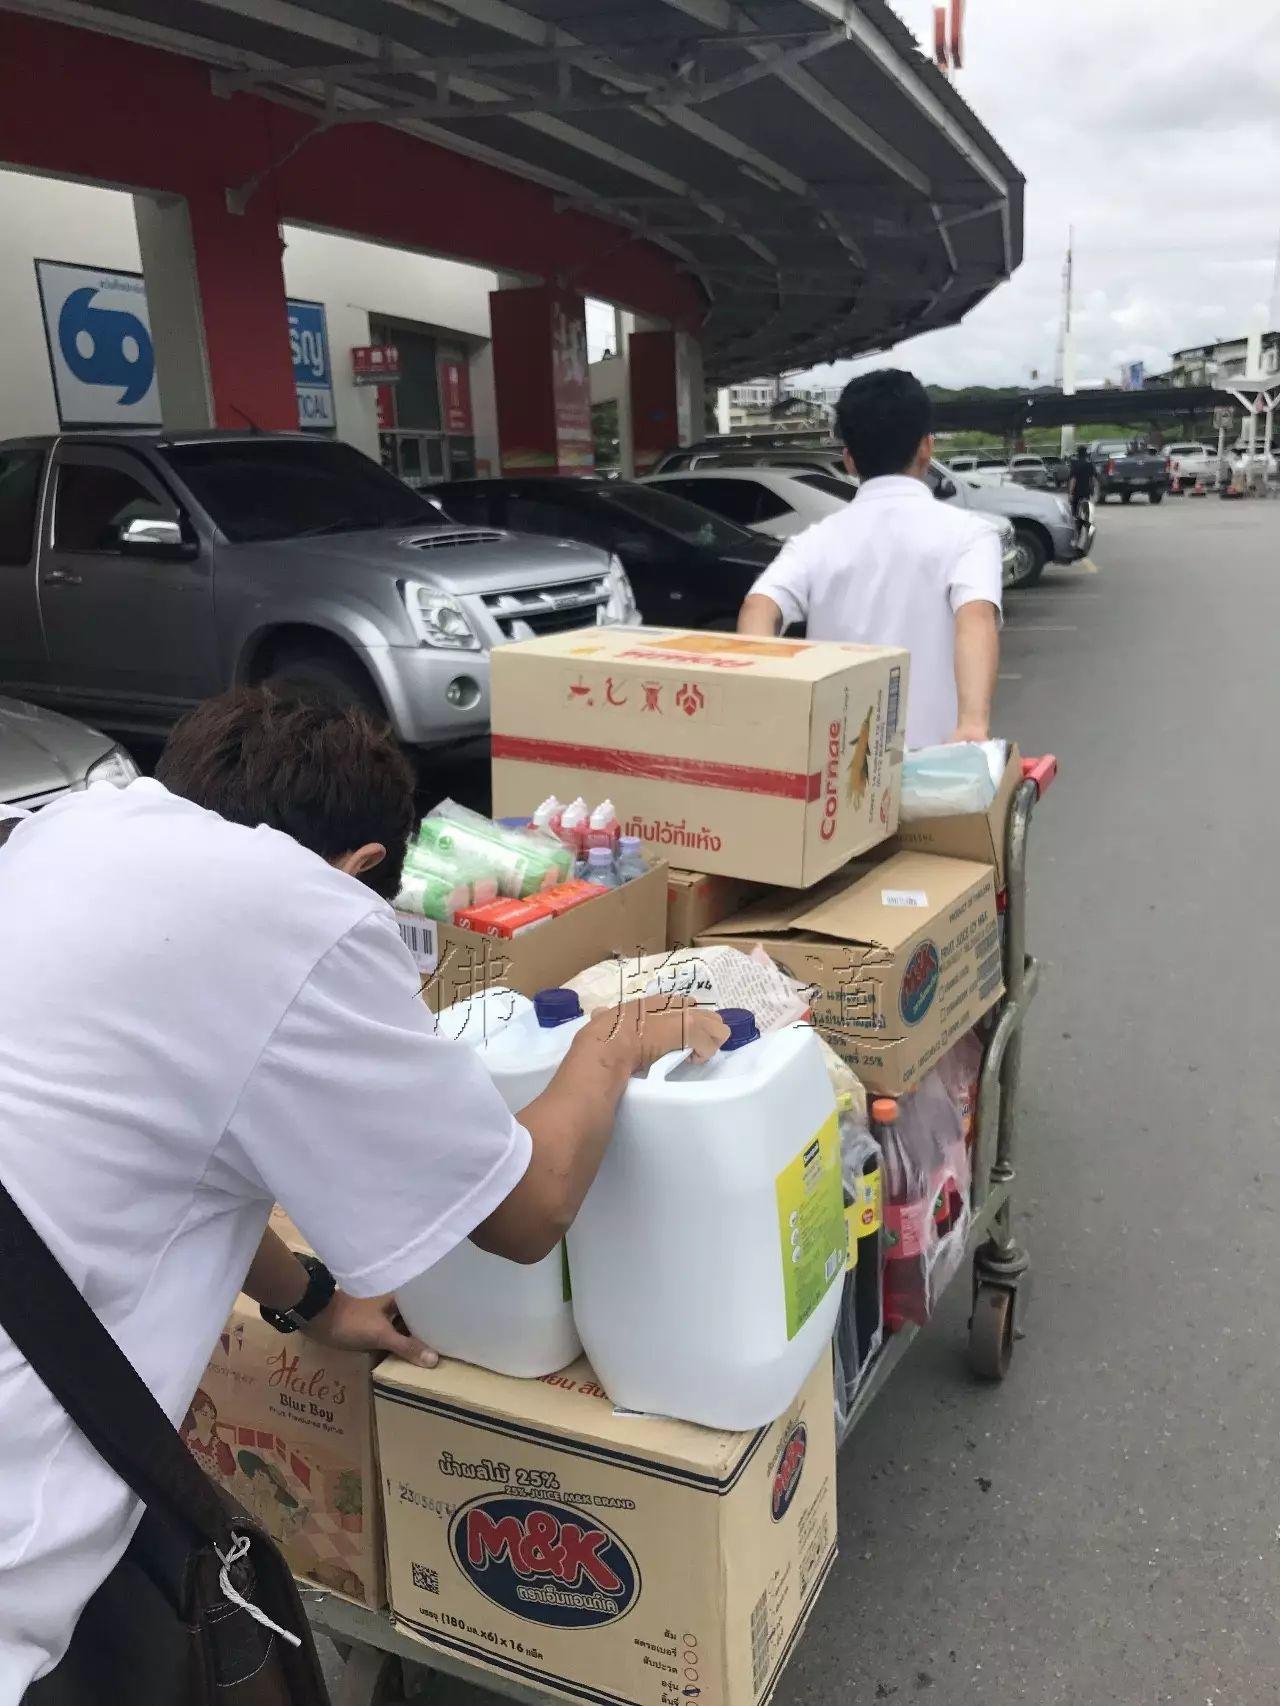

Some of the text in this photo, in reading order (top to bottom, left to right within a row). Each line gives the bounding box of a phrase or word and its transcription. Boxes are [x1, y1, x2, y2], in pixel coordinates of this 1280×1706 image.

[821, 719, 840, 841] Cornae
[625, 815, 722, 852] เก็บไว้ที่แห้ง
[266, 1346, 346, 1405] Hale's
[309, 1401, 334, 1422] Boy
[438, 1451, 561, 1490] น้ำผลไม้ 25%
[504, 1484, 636, 1511] 25% JUICE M&K BRAND
[467, 1508, 626, 1597] M&K
[516, 1584, 619, 1614] ตราเอ็มแอนด์เค
[441, 1612, 465, 1630] (180
[509, 1639, 524, 1653] 16
